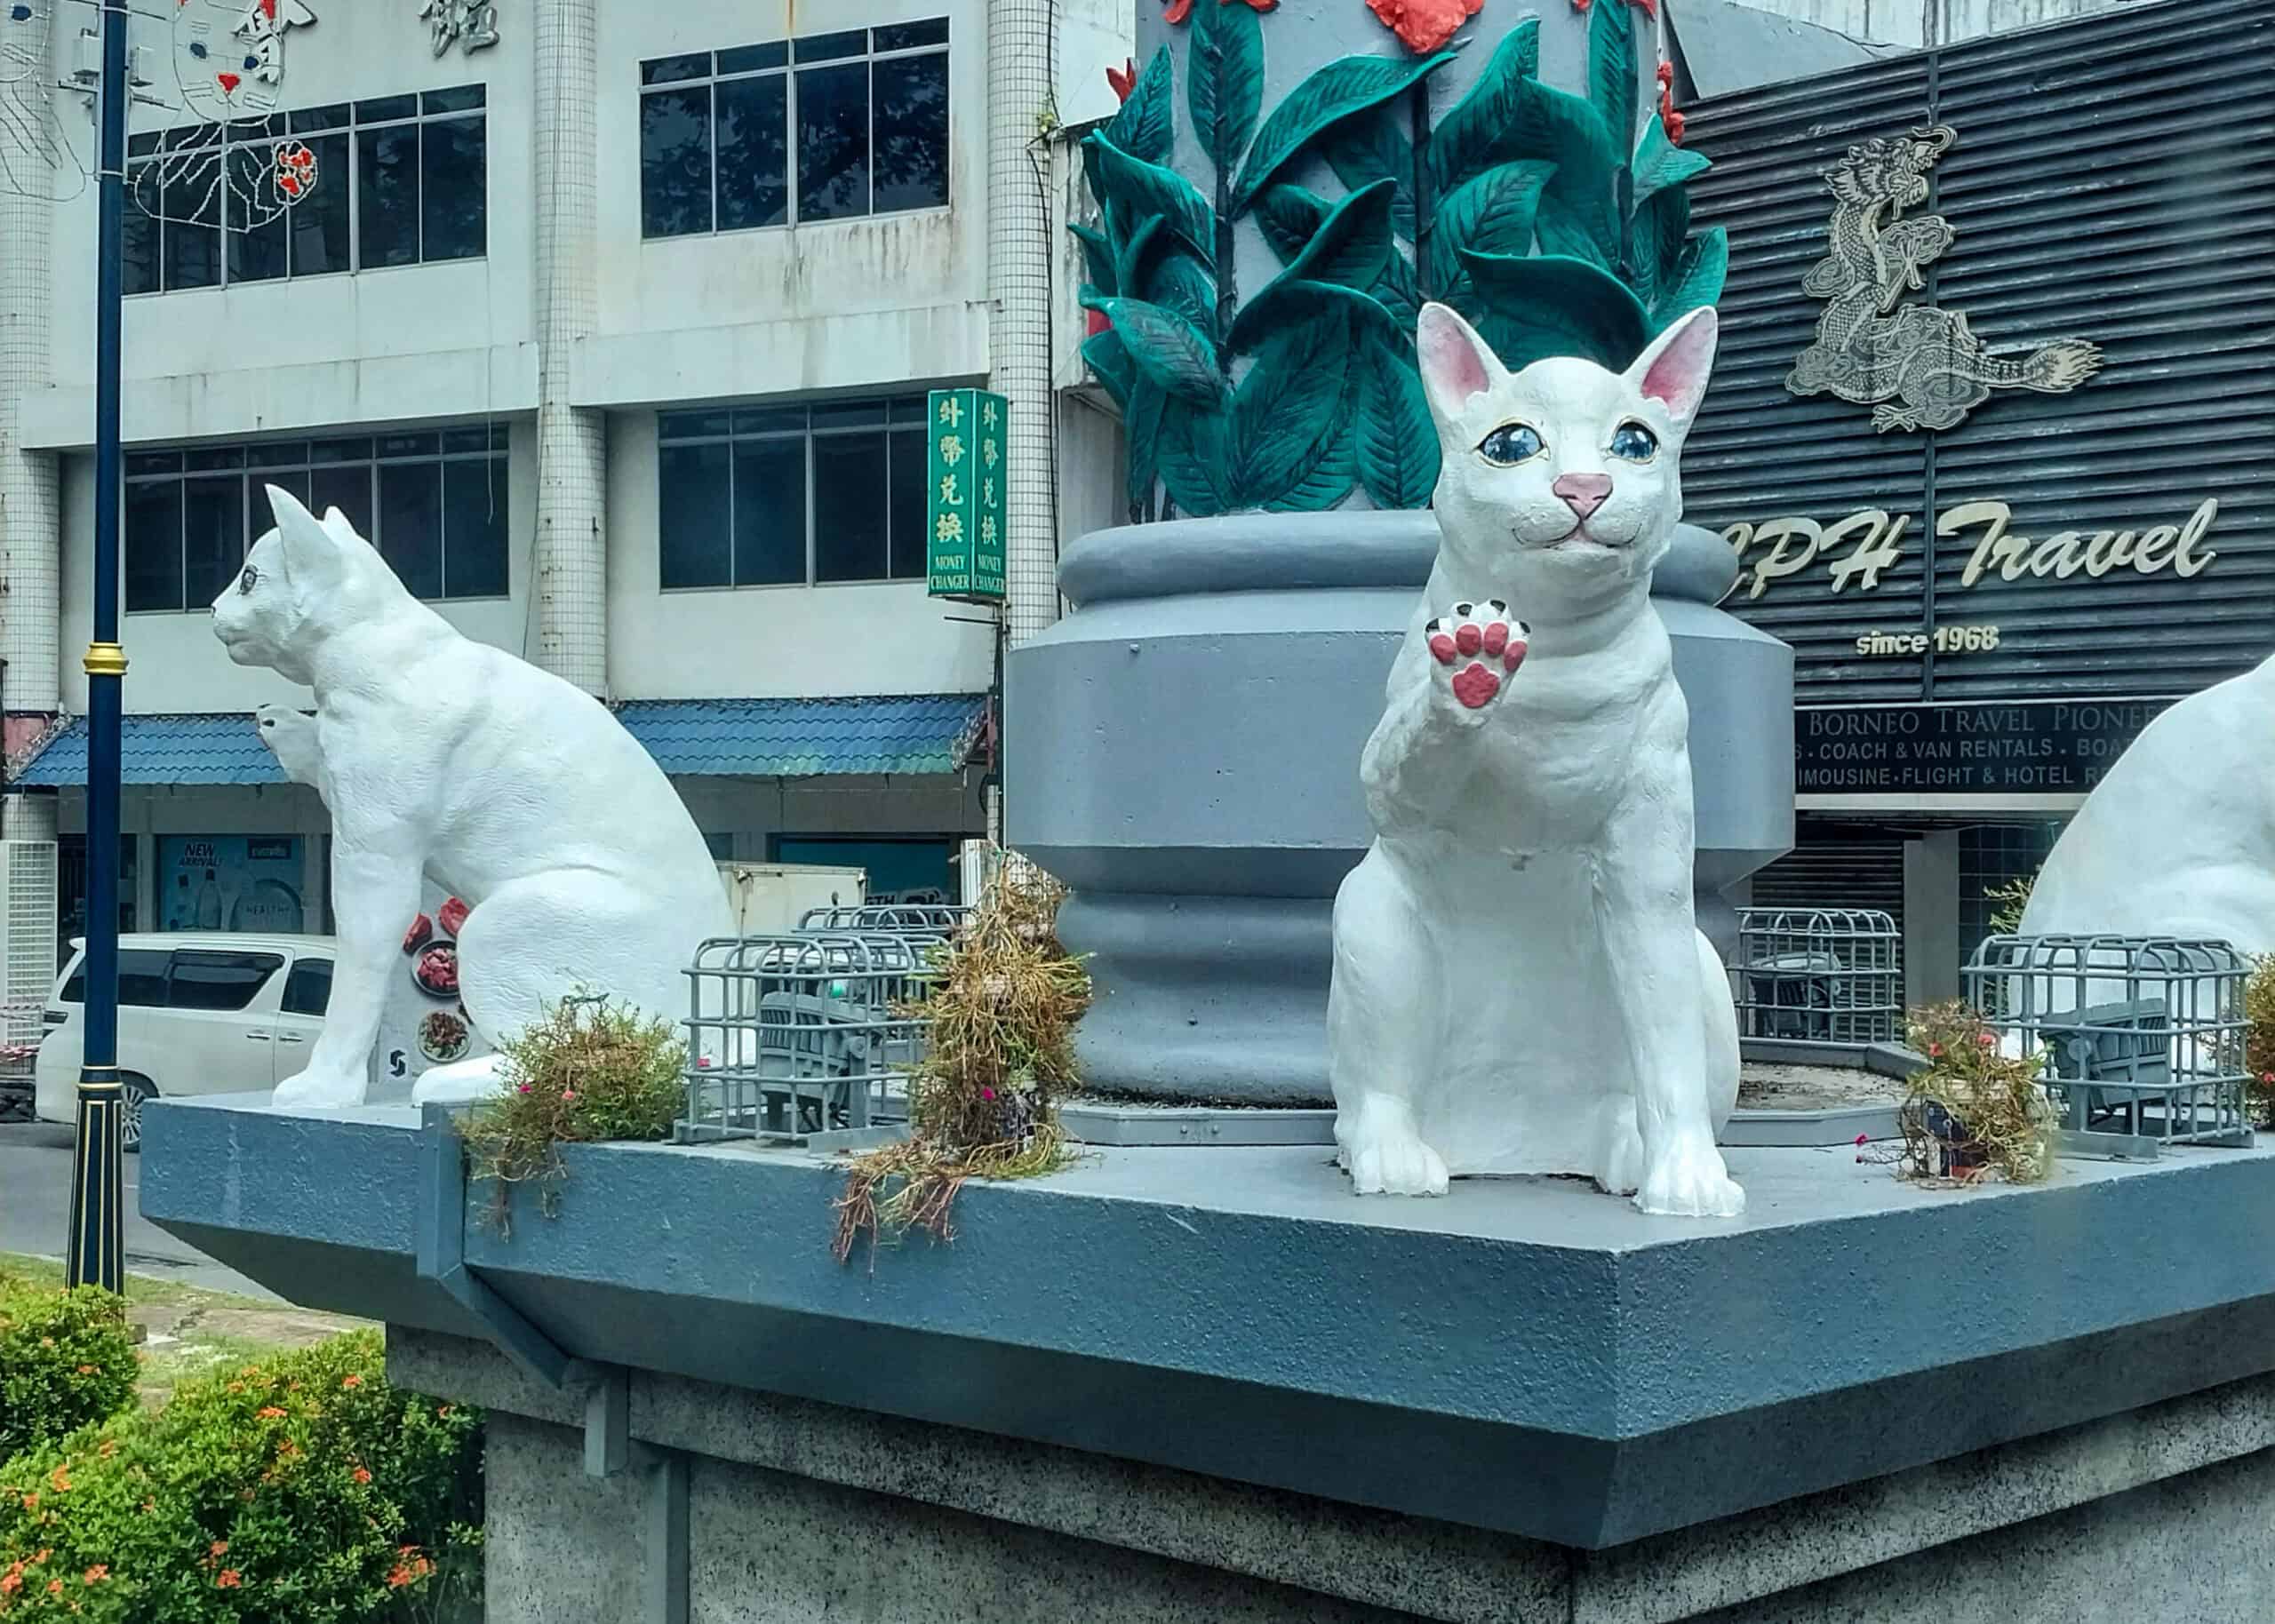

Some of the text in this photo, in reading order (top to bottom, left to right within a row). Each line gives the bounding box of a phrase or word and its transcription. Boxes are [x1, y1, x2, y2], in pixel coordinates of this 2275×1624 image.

[1937, 498, 2218, 587] Travel
[936, 555, 965, 569] MONEY
[978, 554, 1002, 571] MONEY
[930, 576, 970, 590] CHANGER
[975, 575, 1005, 593] CHANGER
[1856, 625, 2000, 656] since 1968
[1820, 743, 1887, 760] COACH
[1896, 742, 1908, 758] &
[1913, 741, 1951, 758] VAN
[1960, 738, 2053, 758] RENTALS
[1799, 768, 1890, 785] IMOUSINE
[1903, 767, 1974, 784] FLIGHT
[1983, 767, 1996, 784] &
[2005, 766, 2074, 784] HOTEL
[185, 844, 214, 856] NEW
